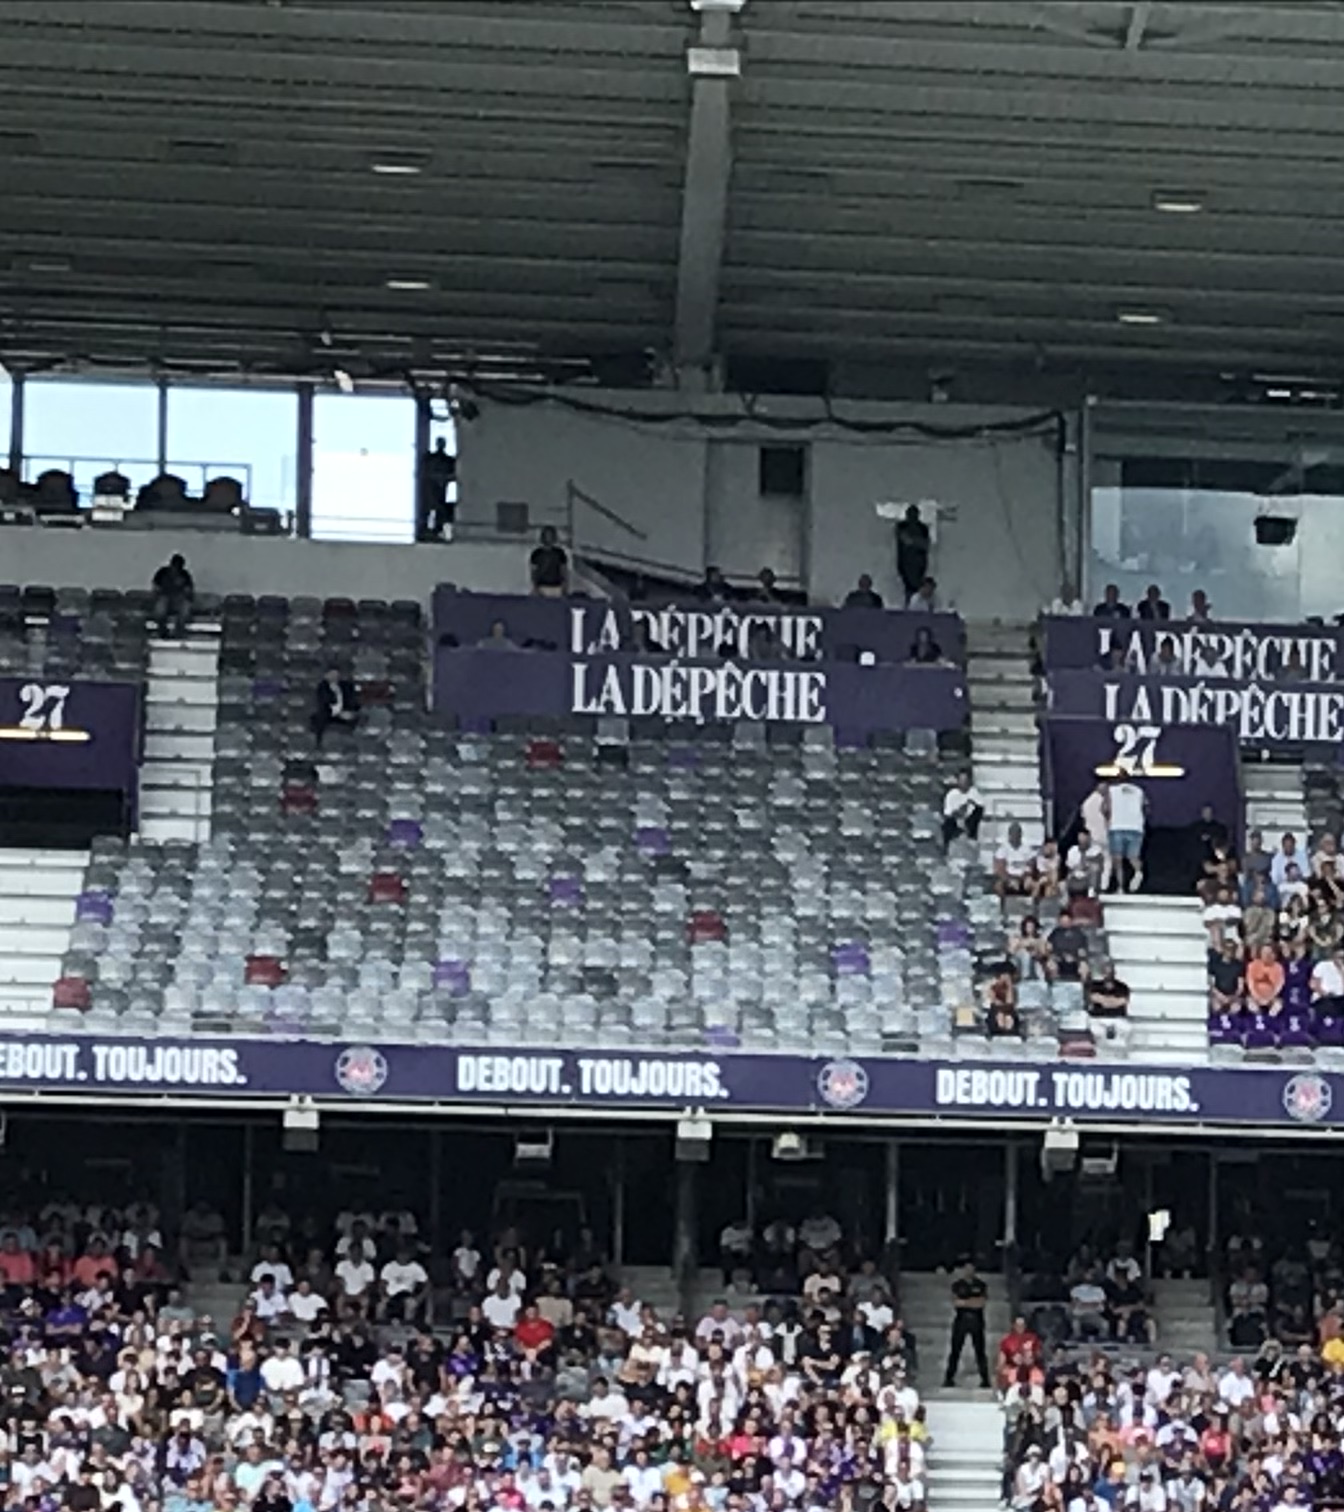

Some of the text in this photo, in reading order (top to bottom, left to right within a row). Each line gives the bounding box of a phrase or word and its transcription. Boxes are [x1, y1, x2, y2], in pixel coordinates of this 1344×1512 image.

[19, 684, 70, 731] 27
[571, 659, 826, 722] LA DÉPÊCHE
[1104, 681, 1344, 742] LA DÉPÊCHE
[1113, 723, 1162, 775] 27
[92, 1045, 247, 1084] TOUJOURS.
[458, 1056, 729, 1098] DEBOUT. TOUJOURS.
[937, 1069, 1199, 1111] DEBOUT. TOUJOURS.
